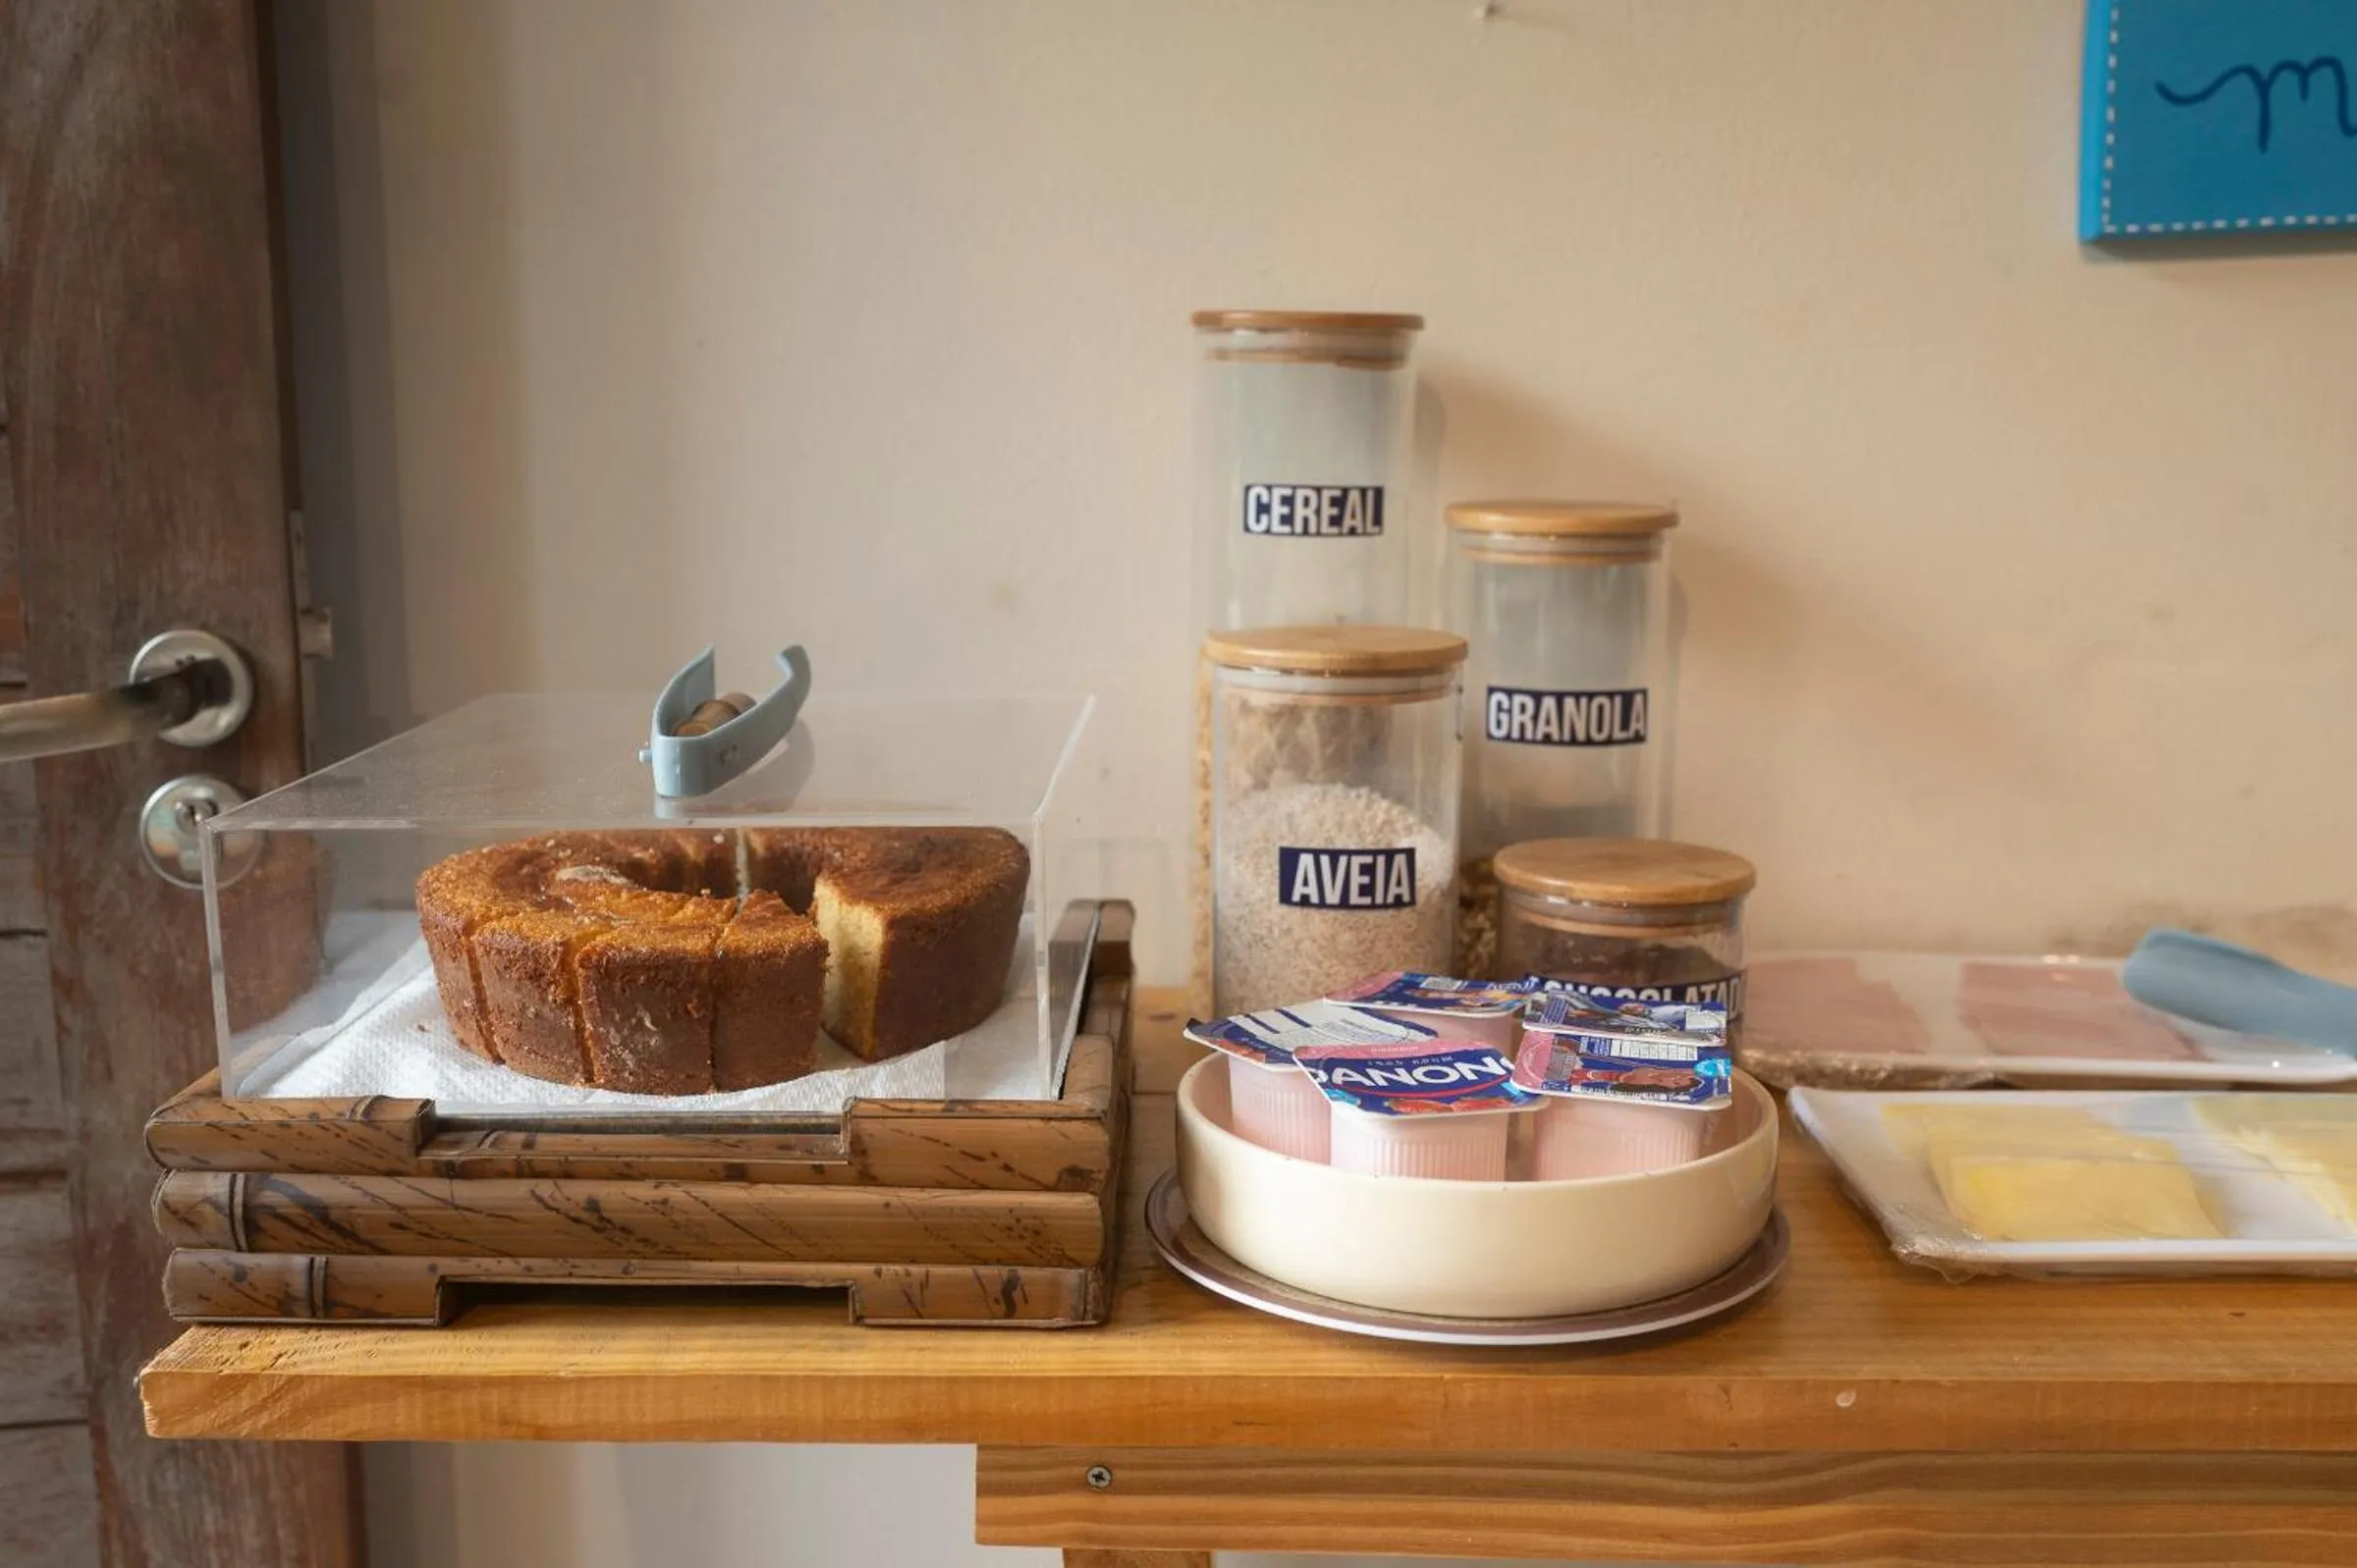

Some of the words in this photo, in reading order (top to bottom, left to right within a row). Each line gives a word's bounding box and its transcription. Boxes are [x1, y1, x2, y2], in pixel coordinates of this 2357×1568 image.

[1246, 486, 1382, 534] CEREAL
[1487, 690, 1646, 742] GRANOLA
[1290, 852, 1411, 905] AVEIA
[1305, 1056, 1515, 1087] ANON
